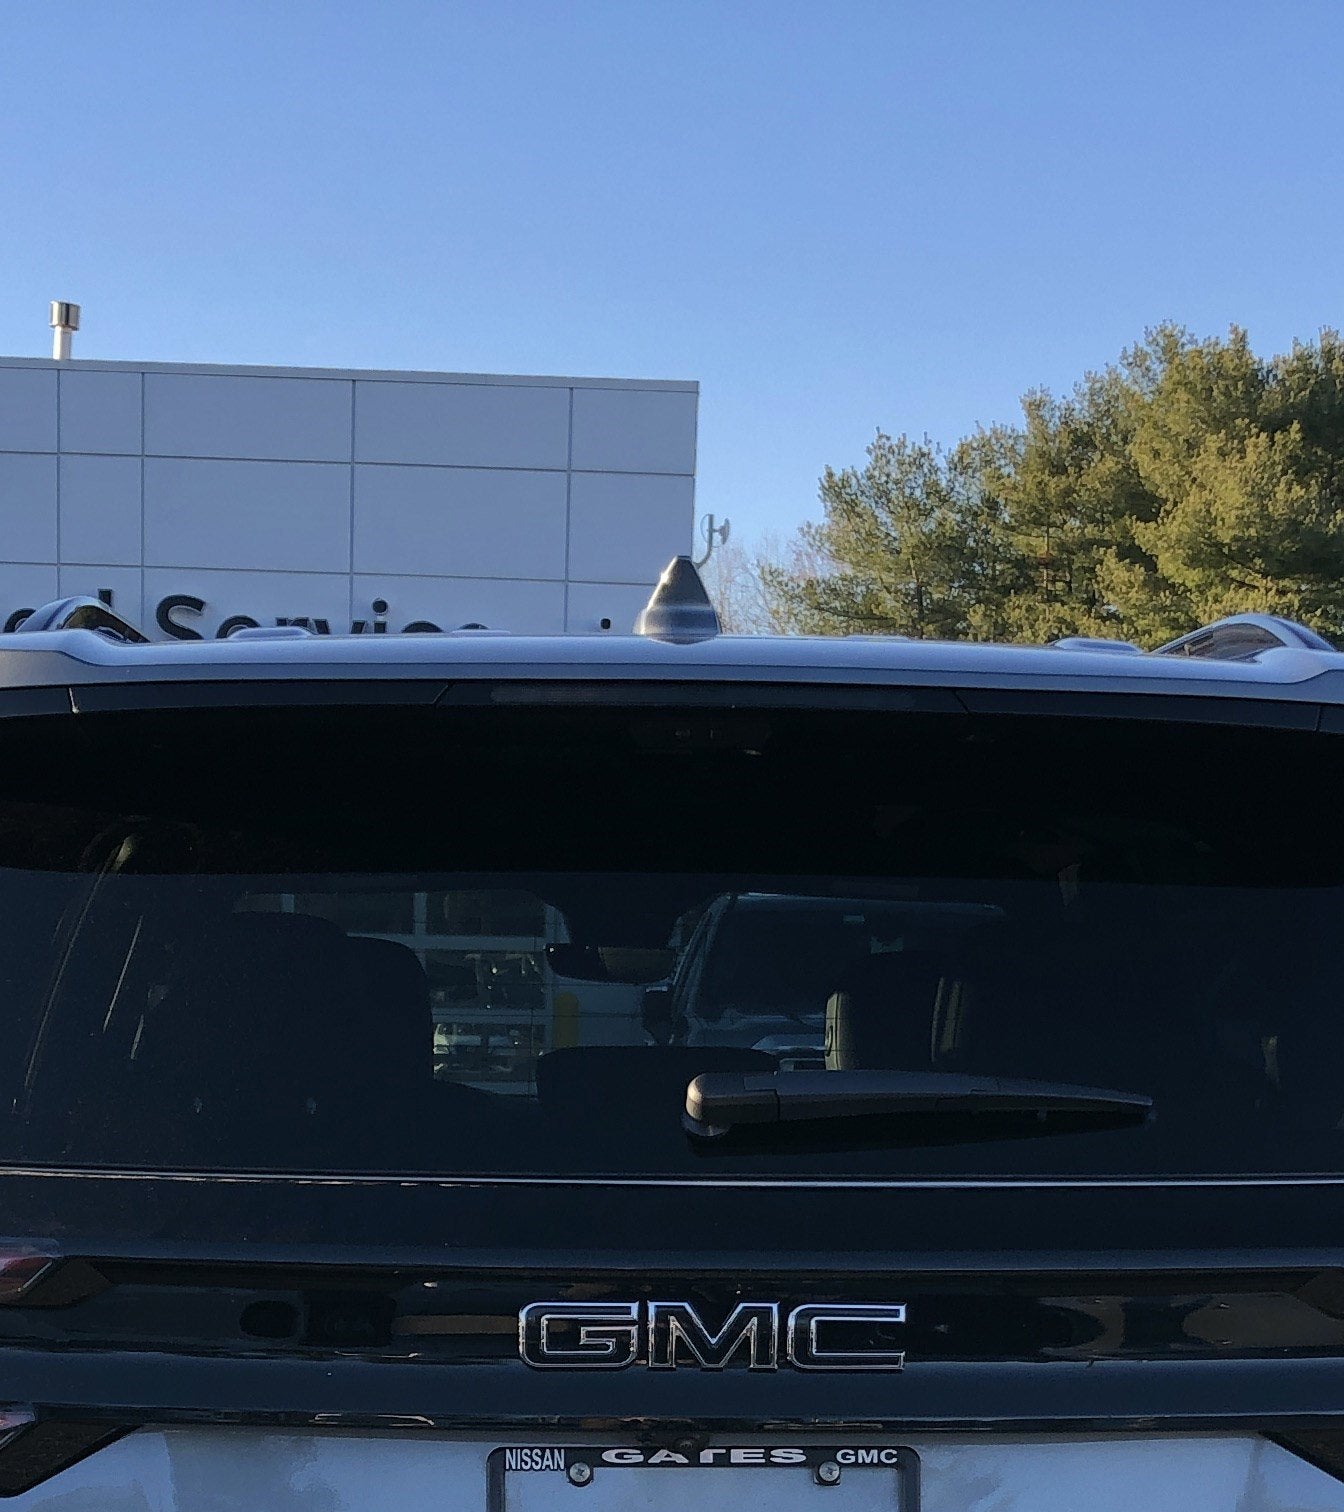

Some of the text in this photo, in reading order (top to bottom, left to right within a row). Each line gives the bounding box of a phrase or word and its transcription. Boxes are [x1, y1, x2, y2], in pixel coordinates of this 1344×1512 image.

[518, 1300, 907, 1370] GMC
[505, 1448, 899, 1471] NISSAN GATES GMC
